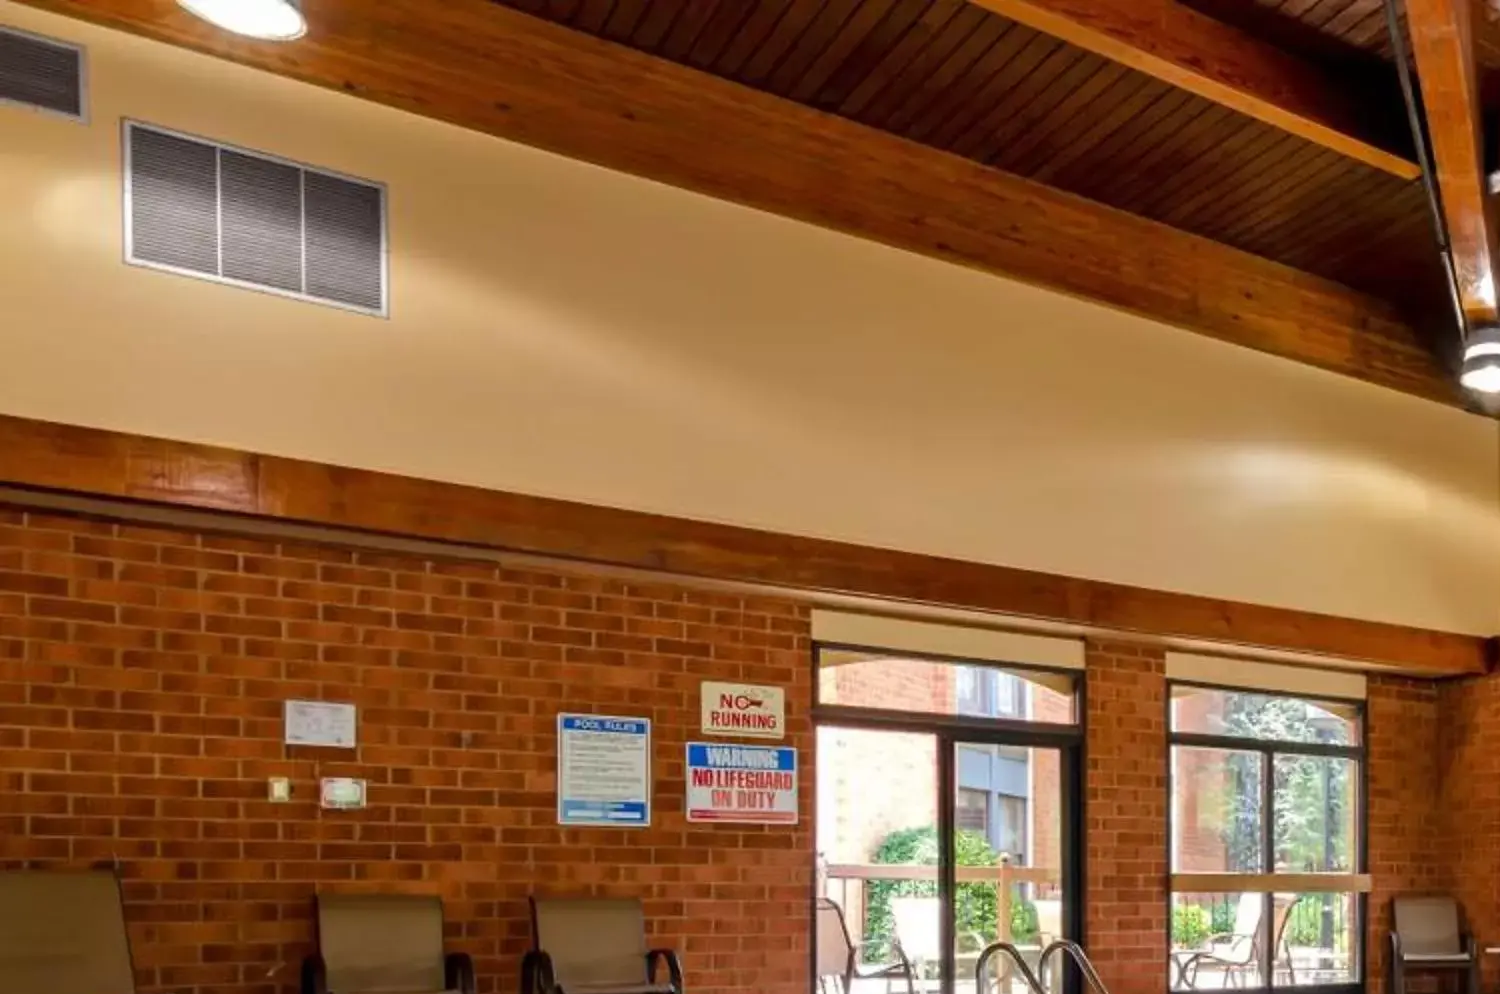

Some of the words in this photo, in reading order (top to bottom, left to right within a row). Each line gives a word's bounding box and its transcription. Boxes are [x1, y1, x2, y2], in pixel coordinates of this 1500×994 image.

[711, 711, 777, 729] RUNNING
[705, 747, 779, 769] WARNING
[692, 768, 713, 788] NO
[717, 770, 793, 790] LIFEGUARD
[711, 789, 732, 807] ON
[737, 790, 776, 809] DUTY
